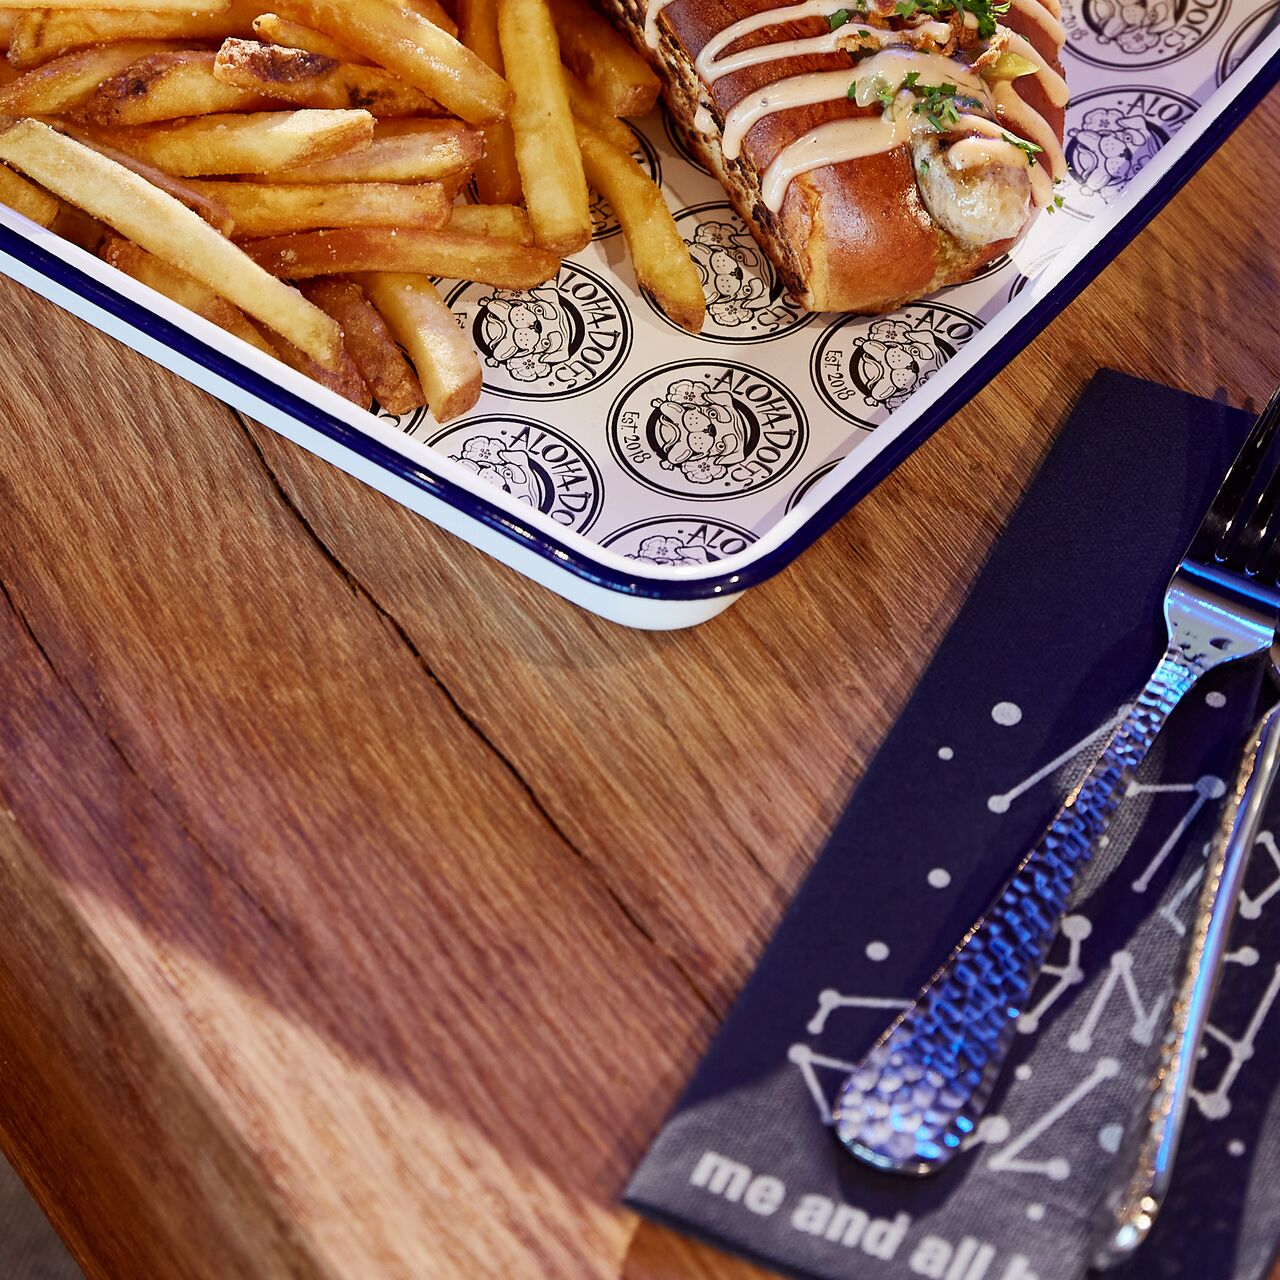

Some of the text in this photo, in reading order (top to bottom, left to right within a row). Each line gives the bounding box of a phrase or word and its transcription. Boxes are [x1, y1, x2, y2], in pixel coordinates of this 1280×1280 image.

[828, 373, 856, 400] 2018
[624, 435, 652, 464] 2018
[689, 1150, 787, 1217] me
[790, 1193, 912, 1261] and
[909, 1235, 997, 1280] all
